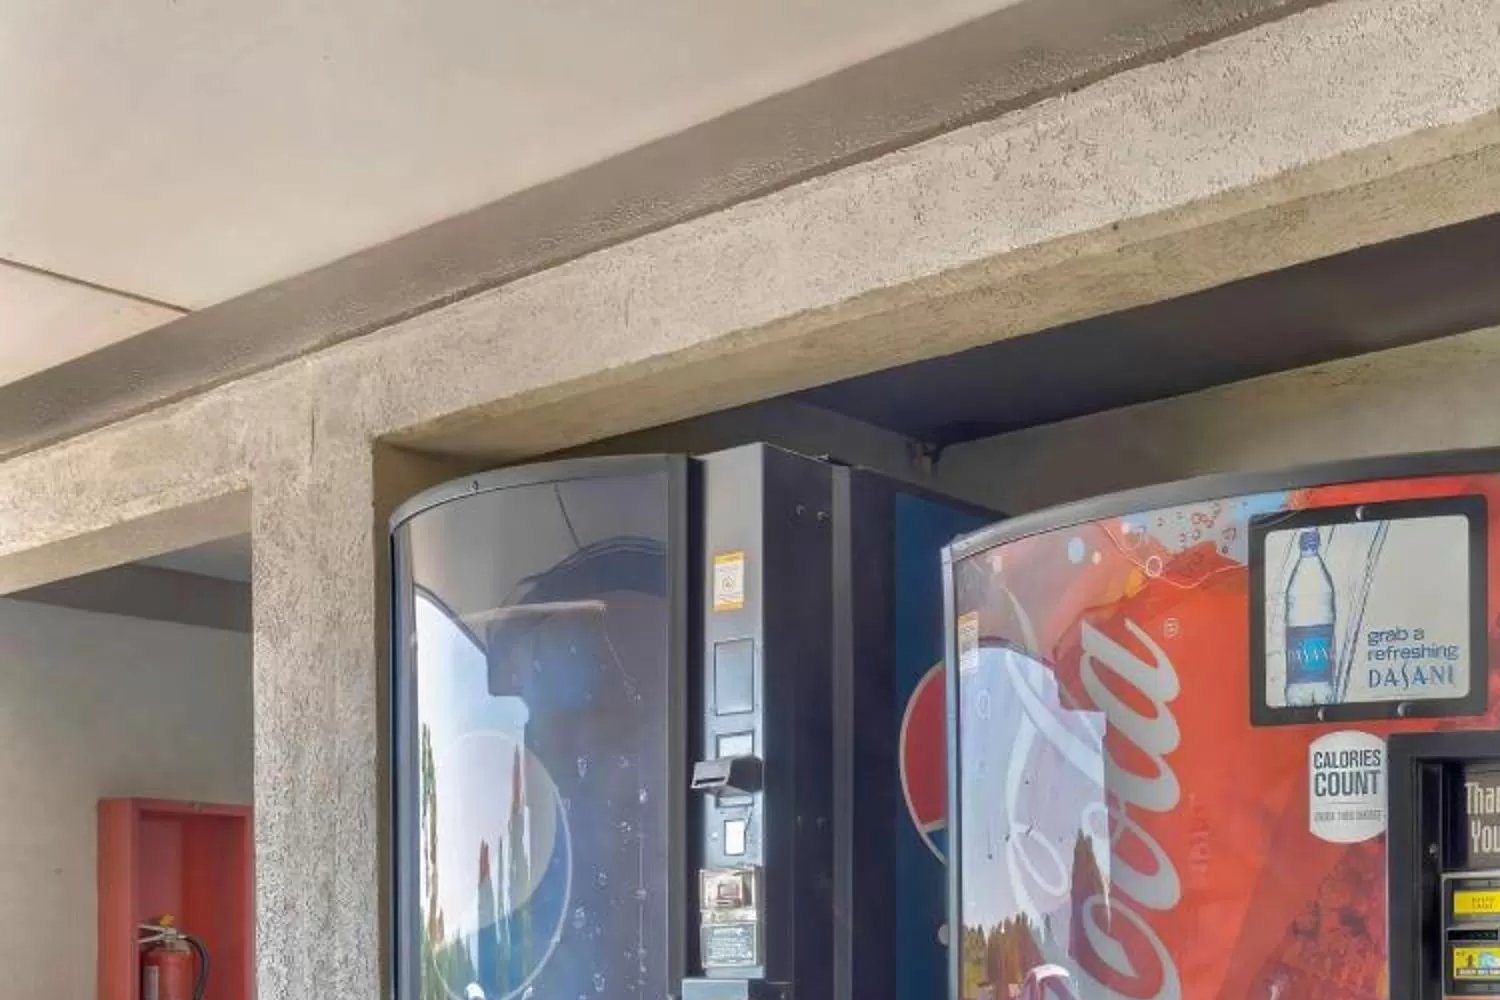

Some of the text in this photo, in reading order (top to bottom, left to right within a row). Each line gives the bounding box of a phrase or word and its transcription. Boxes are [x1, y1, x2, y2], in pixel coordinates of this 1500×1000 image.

[1367, 625, 1425, 647] grab a
[1367, 643, 1460, 662] refreshing
[1368, 661, 1455, 691] DASANI
[1313, 749, 1381, 769] CALORIES
[1314, 770, 1381, 797] COUNT
